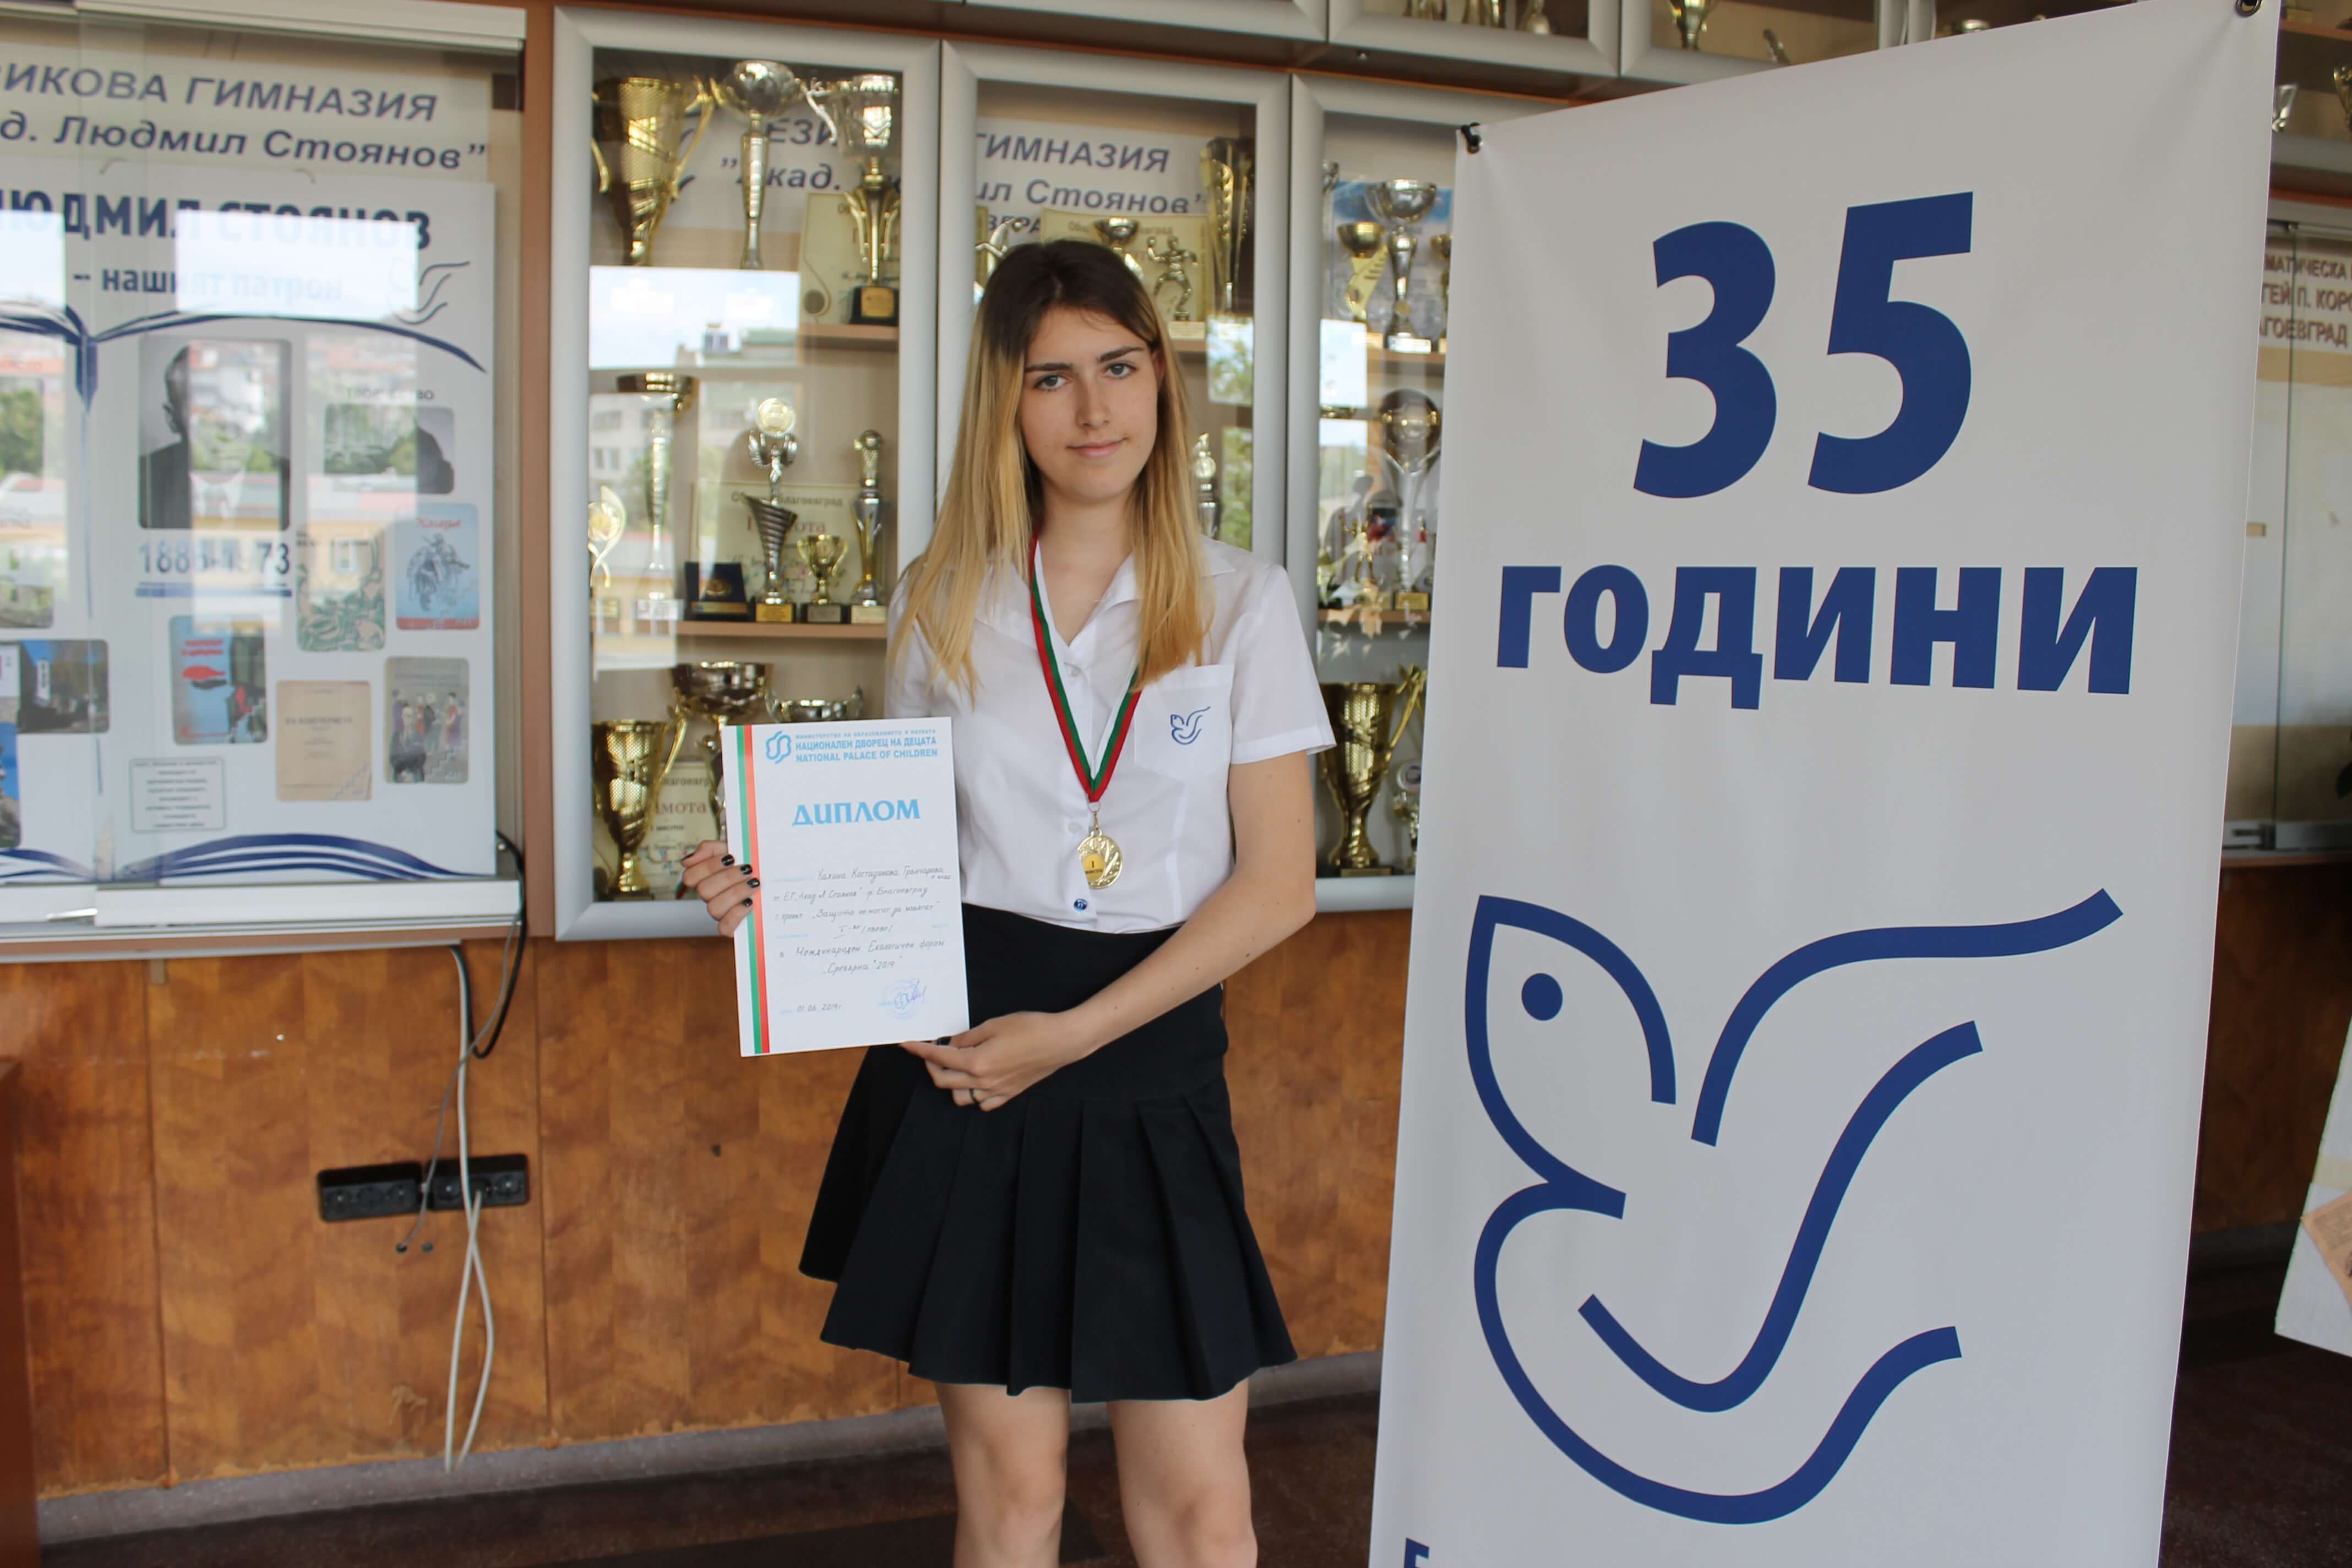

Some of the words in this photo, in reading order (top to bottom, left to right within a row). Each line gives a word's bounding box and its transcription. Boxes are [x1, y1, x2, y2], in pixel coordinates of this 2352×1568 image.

[0, 63, 167, 102] ИКОВА
[185, 77, 438, 122] ГИМНАЗИЯ
[53, 116, 246, 155] Людмил
[0, 189, 201, 241] ЮДМИЛ
[1633, 190, 1973, 498] 35
[796, 740, 853, 751] НАЦИОНАЛЕН
[854, 738, 888, 749] ДВОРЕЦ
[904, 736, 937, 746] ДЕЦАТА
[796, 753, 841, 763] NATIONAL
[843, 751, 876, 760] PALACE
[880, 750, 891, 759] OF
[894, 749, 938, 758] CHILDREN
[792, 798, 921, 827] ДИПЛОМ
